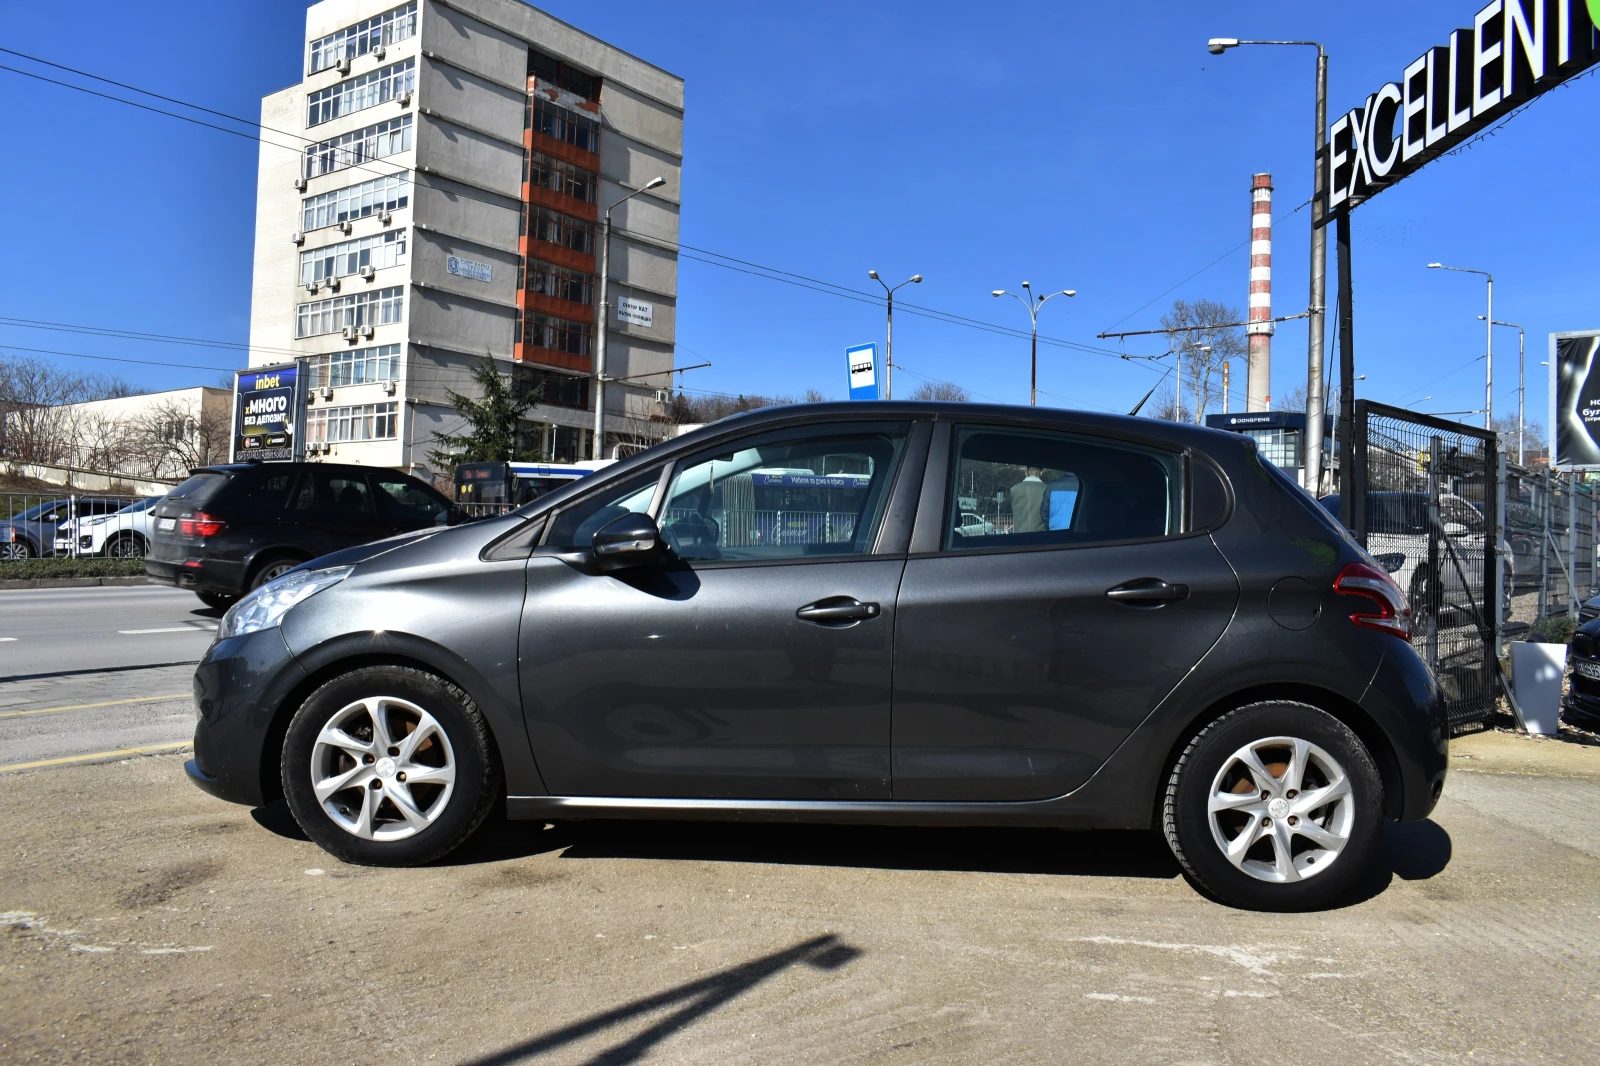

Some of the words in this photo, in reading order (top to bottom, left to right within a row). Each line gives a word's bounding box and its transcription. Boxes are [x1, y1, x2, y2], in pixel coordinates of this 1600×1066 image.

[255, 374, 280, 390] inbet
[244, 415, 256, 426] БЕЗ
[256, 413, 286, 426] ДЕПОЗИТ
